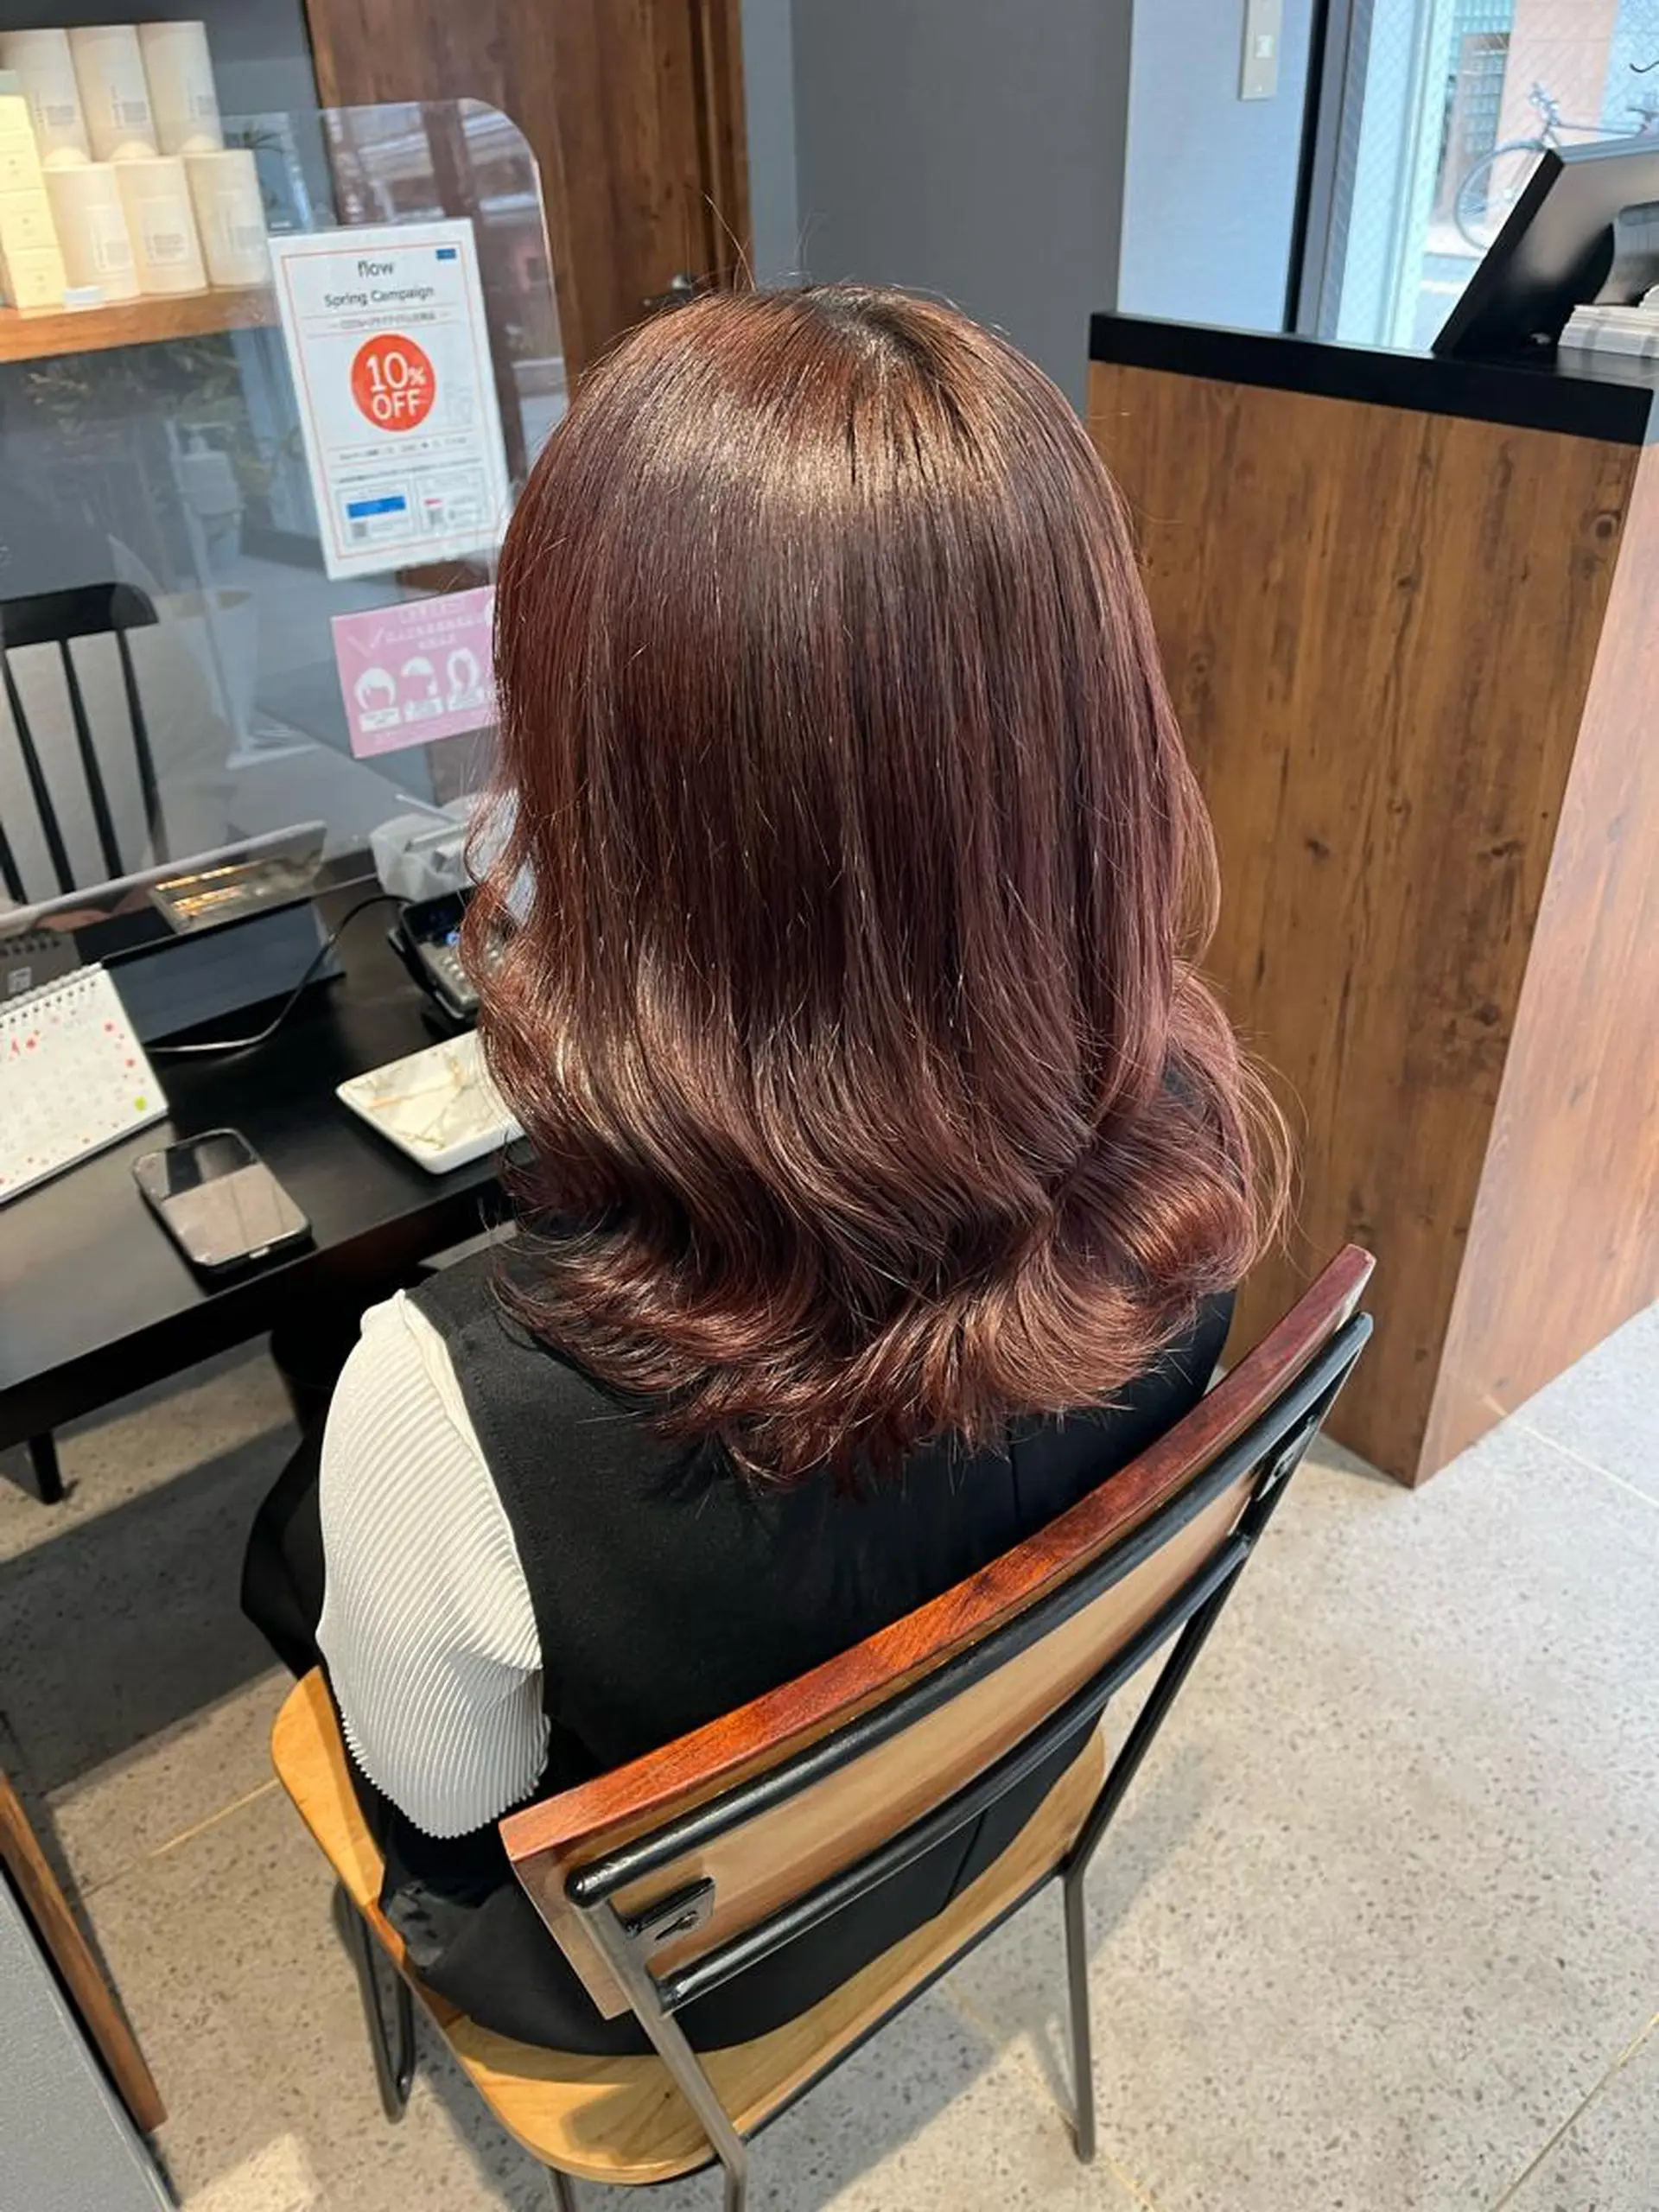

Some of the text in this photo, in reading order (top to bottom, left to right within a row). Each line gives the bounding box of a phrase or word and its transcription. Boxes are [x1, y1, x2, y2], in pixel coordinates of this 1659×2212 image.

[358, 260, 394, 277] flow
[324, 286, 435, 308] Spring Campaign
[366, 351, 427, 392] 10%
[372, 388, 421, 420] OFF
